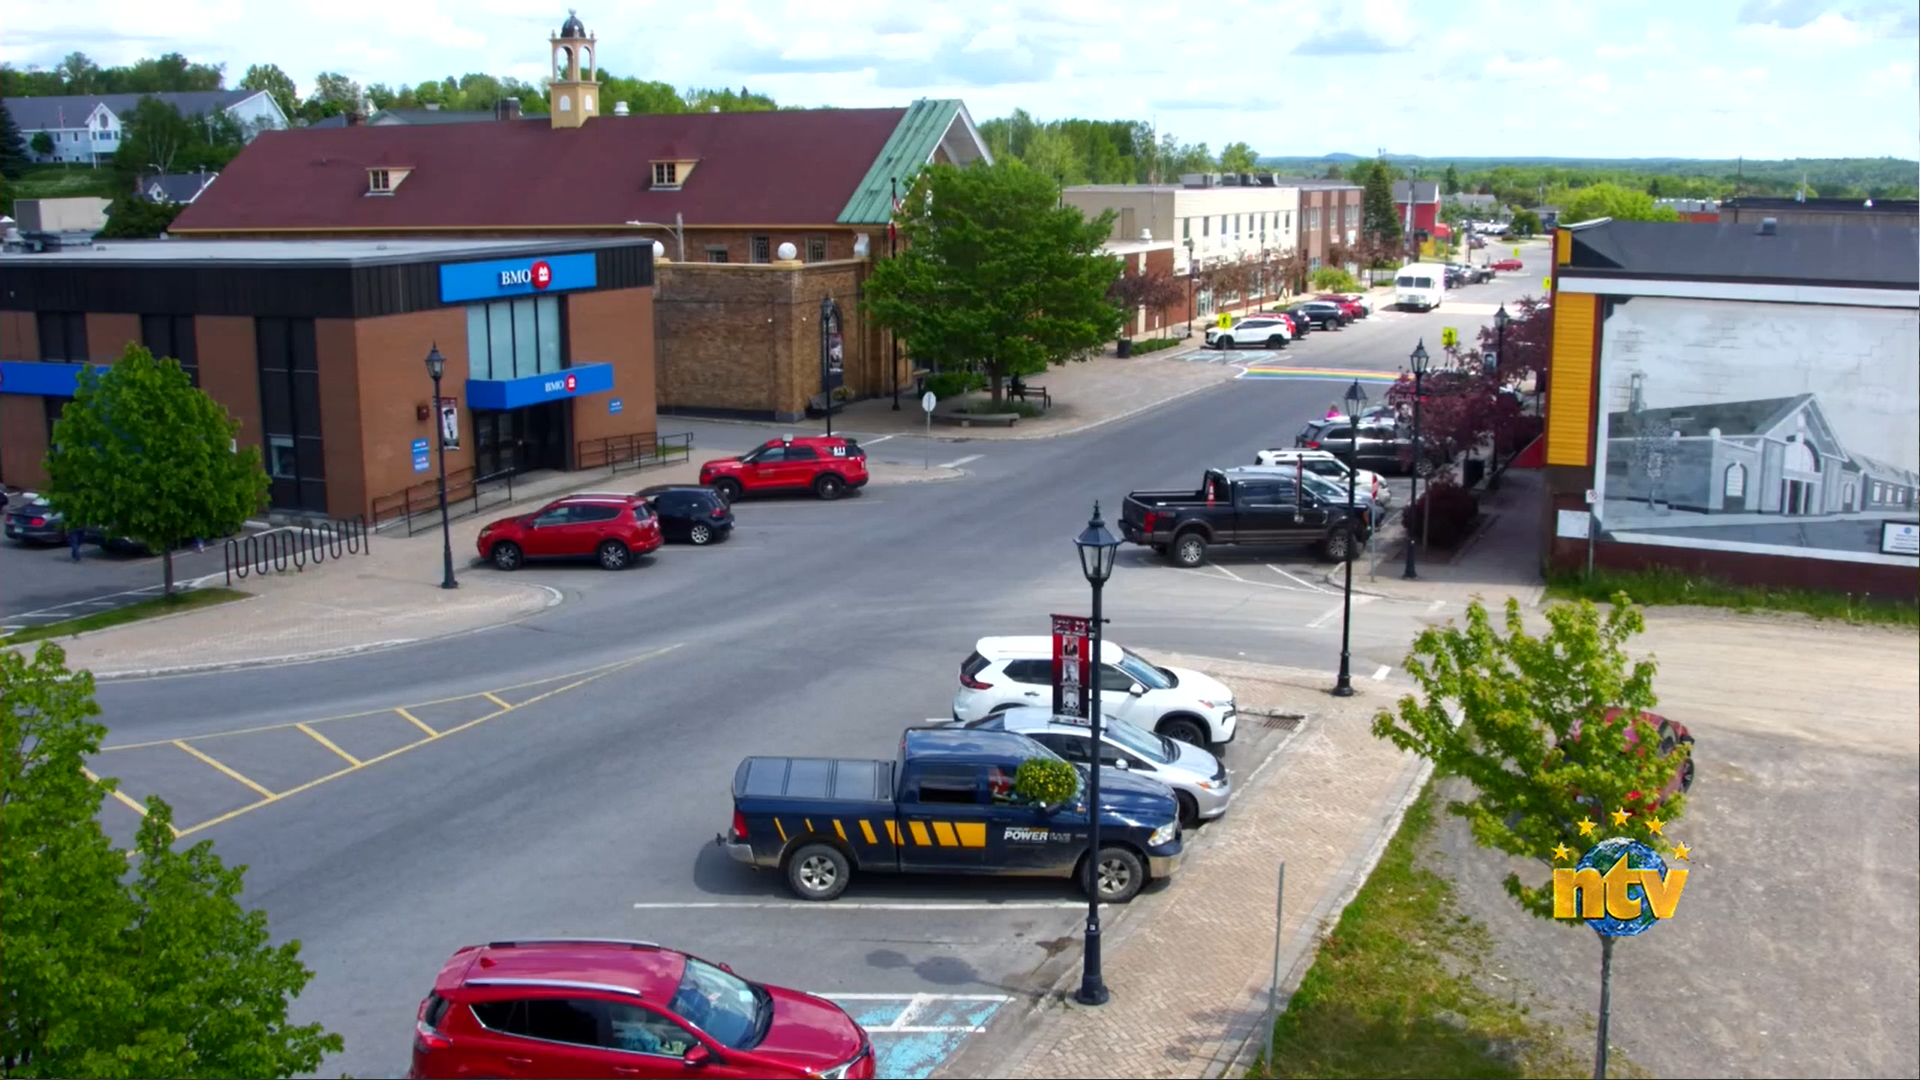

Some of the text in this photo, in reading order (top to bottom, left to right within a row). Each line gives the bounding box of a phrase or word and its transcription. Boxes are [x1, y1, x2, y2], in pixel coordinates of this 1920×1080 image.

[501, 269, 531, 286] BMO
[545, 380, 565, 392] BMO
[1003, 831, 1048, 840] POWER
